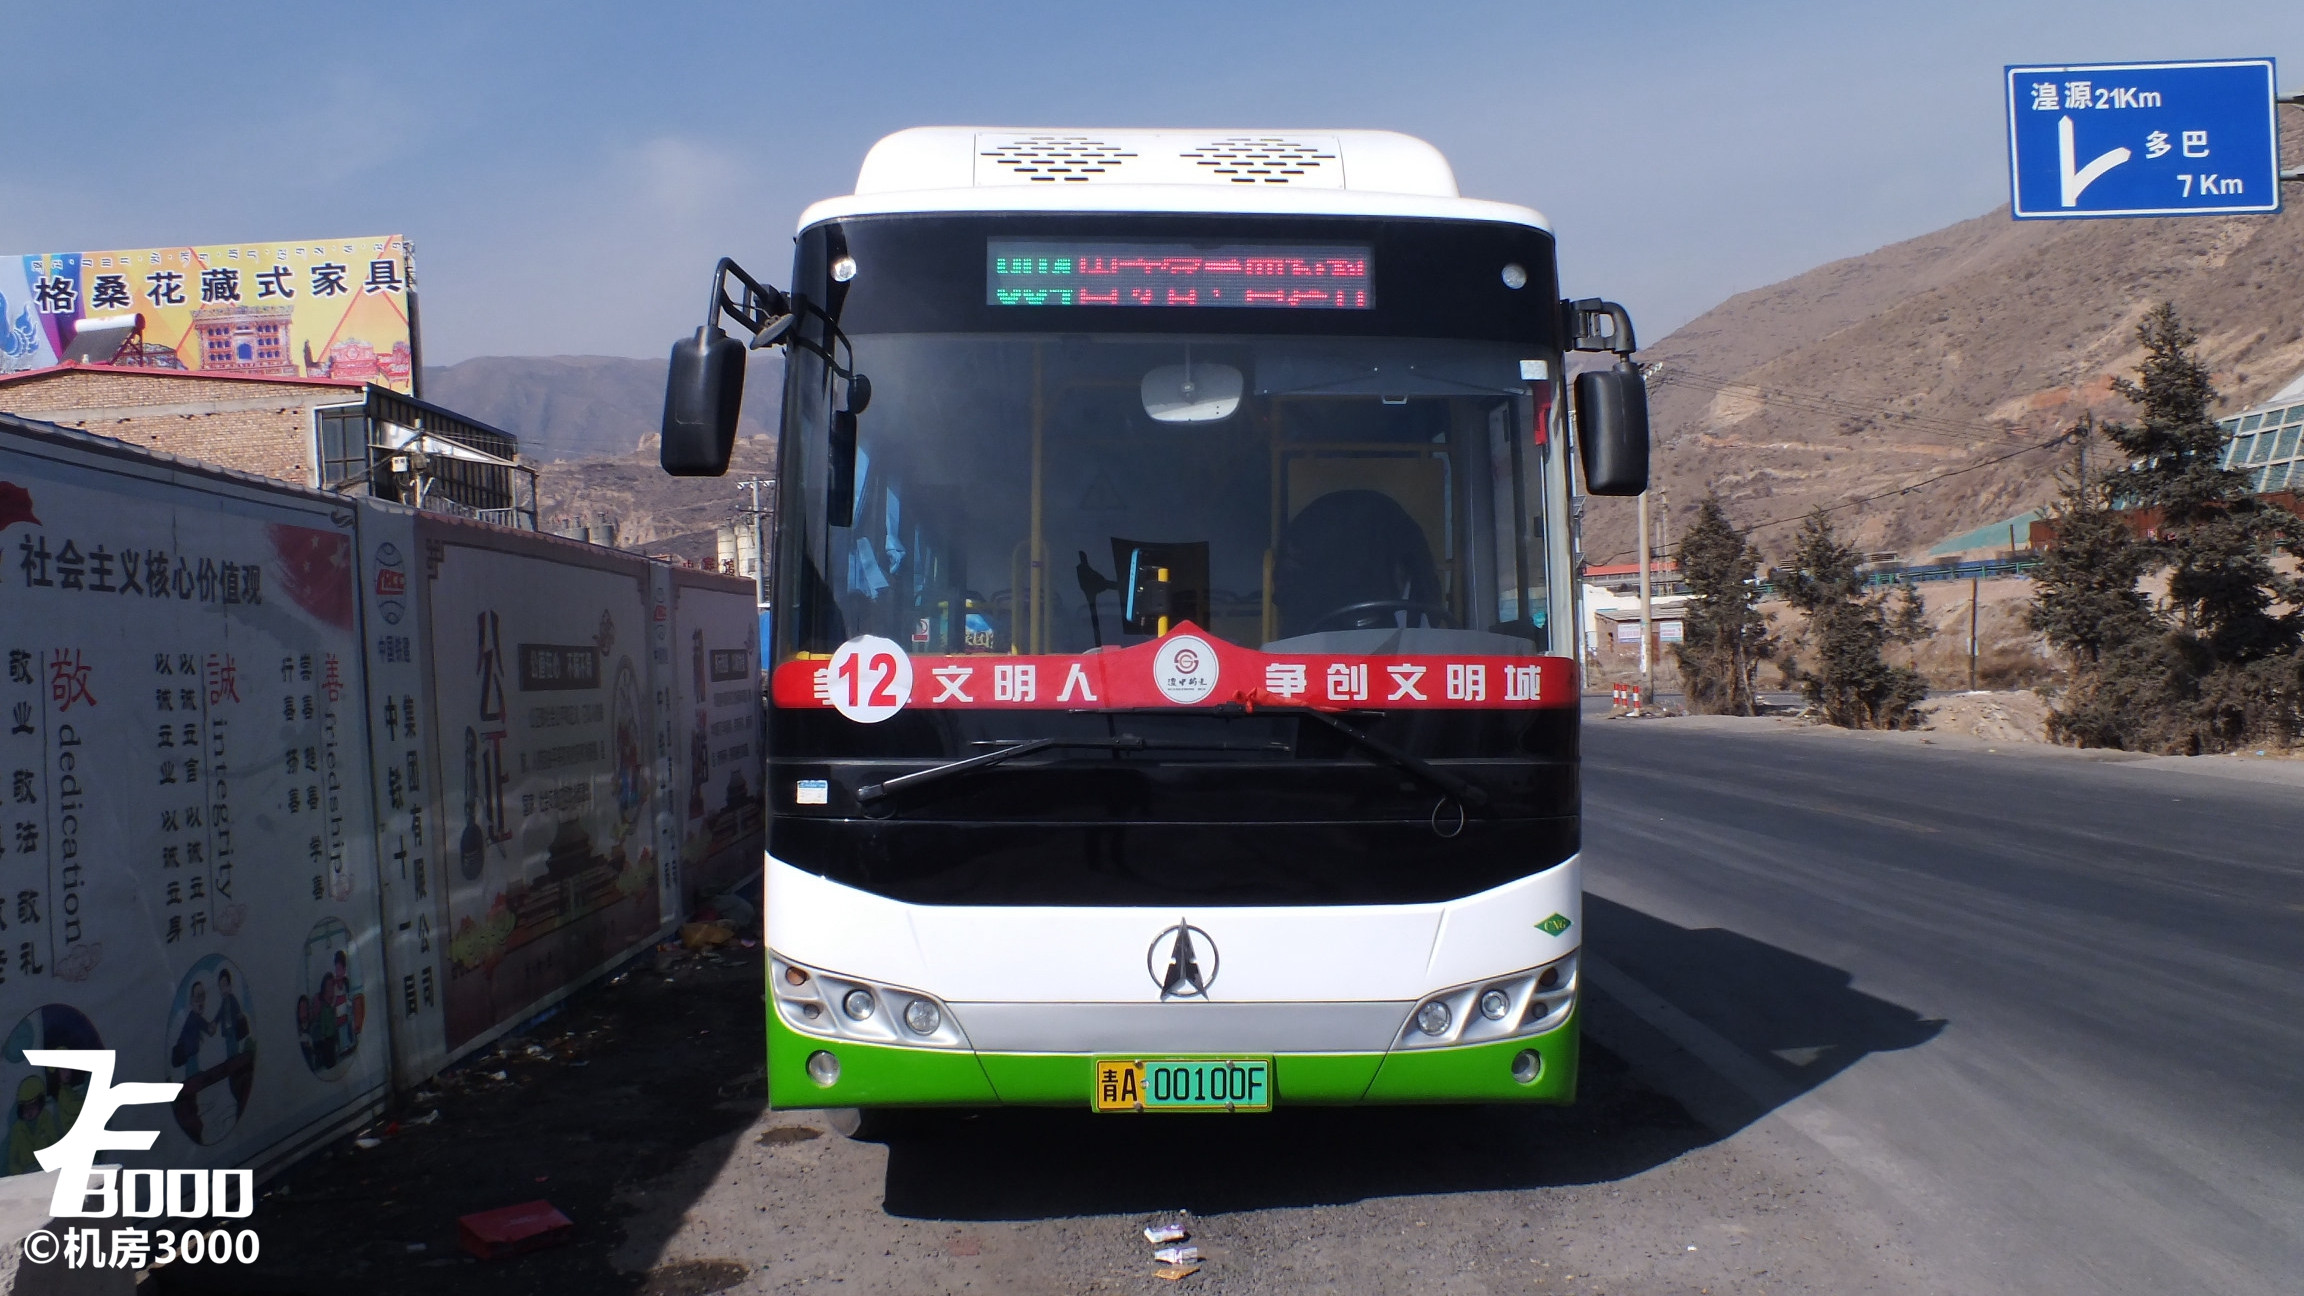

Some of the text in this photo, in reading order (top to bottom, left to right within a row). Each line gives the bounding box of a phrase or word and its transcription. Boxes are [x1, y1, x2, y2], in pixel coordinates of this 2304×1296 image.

[2031, 81, 2092, 110] 湟源
[2145, 130, 2210, 159] 多巴
[35, 258, 404, 314] 格桑花藏式家具
[18, 533, 262, 606] 社会主义核心价值观
[50, 648, 97, 714] 敬
[838, 652, 898, 708] 12
[1265, 662, 1542, 701] 争创文明城
[477, 609, 513, 845] 公正
[58, 723, 85, 944] dedication
[212, 718, 235, 900] integrity
[383, 694, 418, 1018] 中铁十一局
[403, 694, 435, 1008] 集团有限公司
